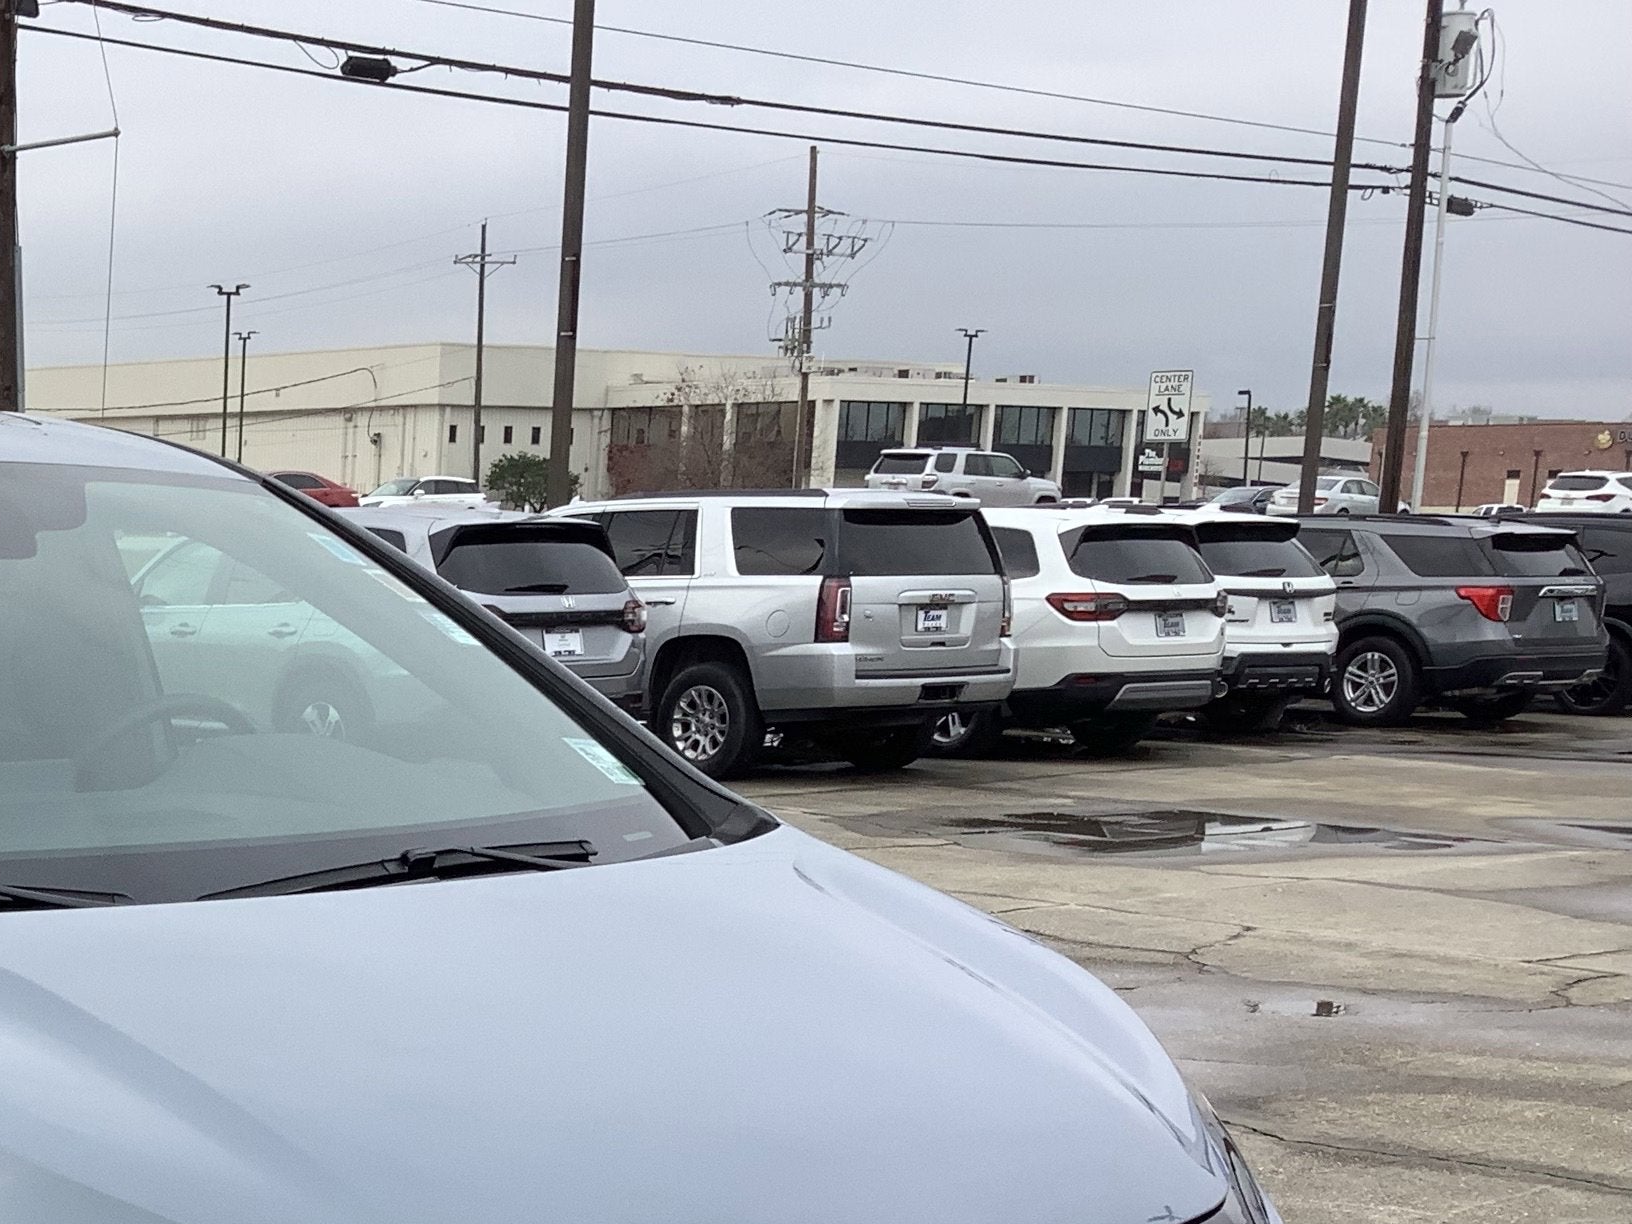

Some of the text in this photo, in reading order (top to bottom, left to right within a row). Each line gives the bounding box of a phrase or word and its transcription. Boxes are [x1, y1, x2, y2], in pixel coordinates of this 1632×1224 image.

[1153, 374, 1190, 384] CENTER
[1157, 384, 1184, 393] LANE
[1154, 428, 1179, 437] ONLY
